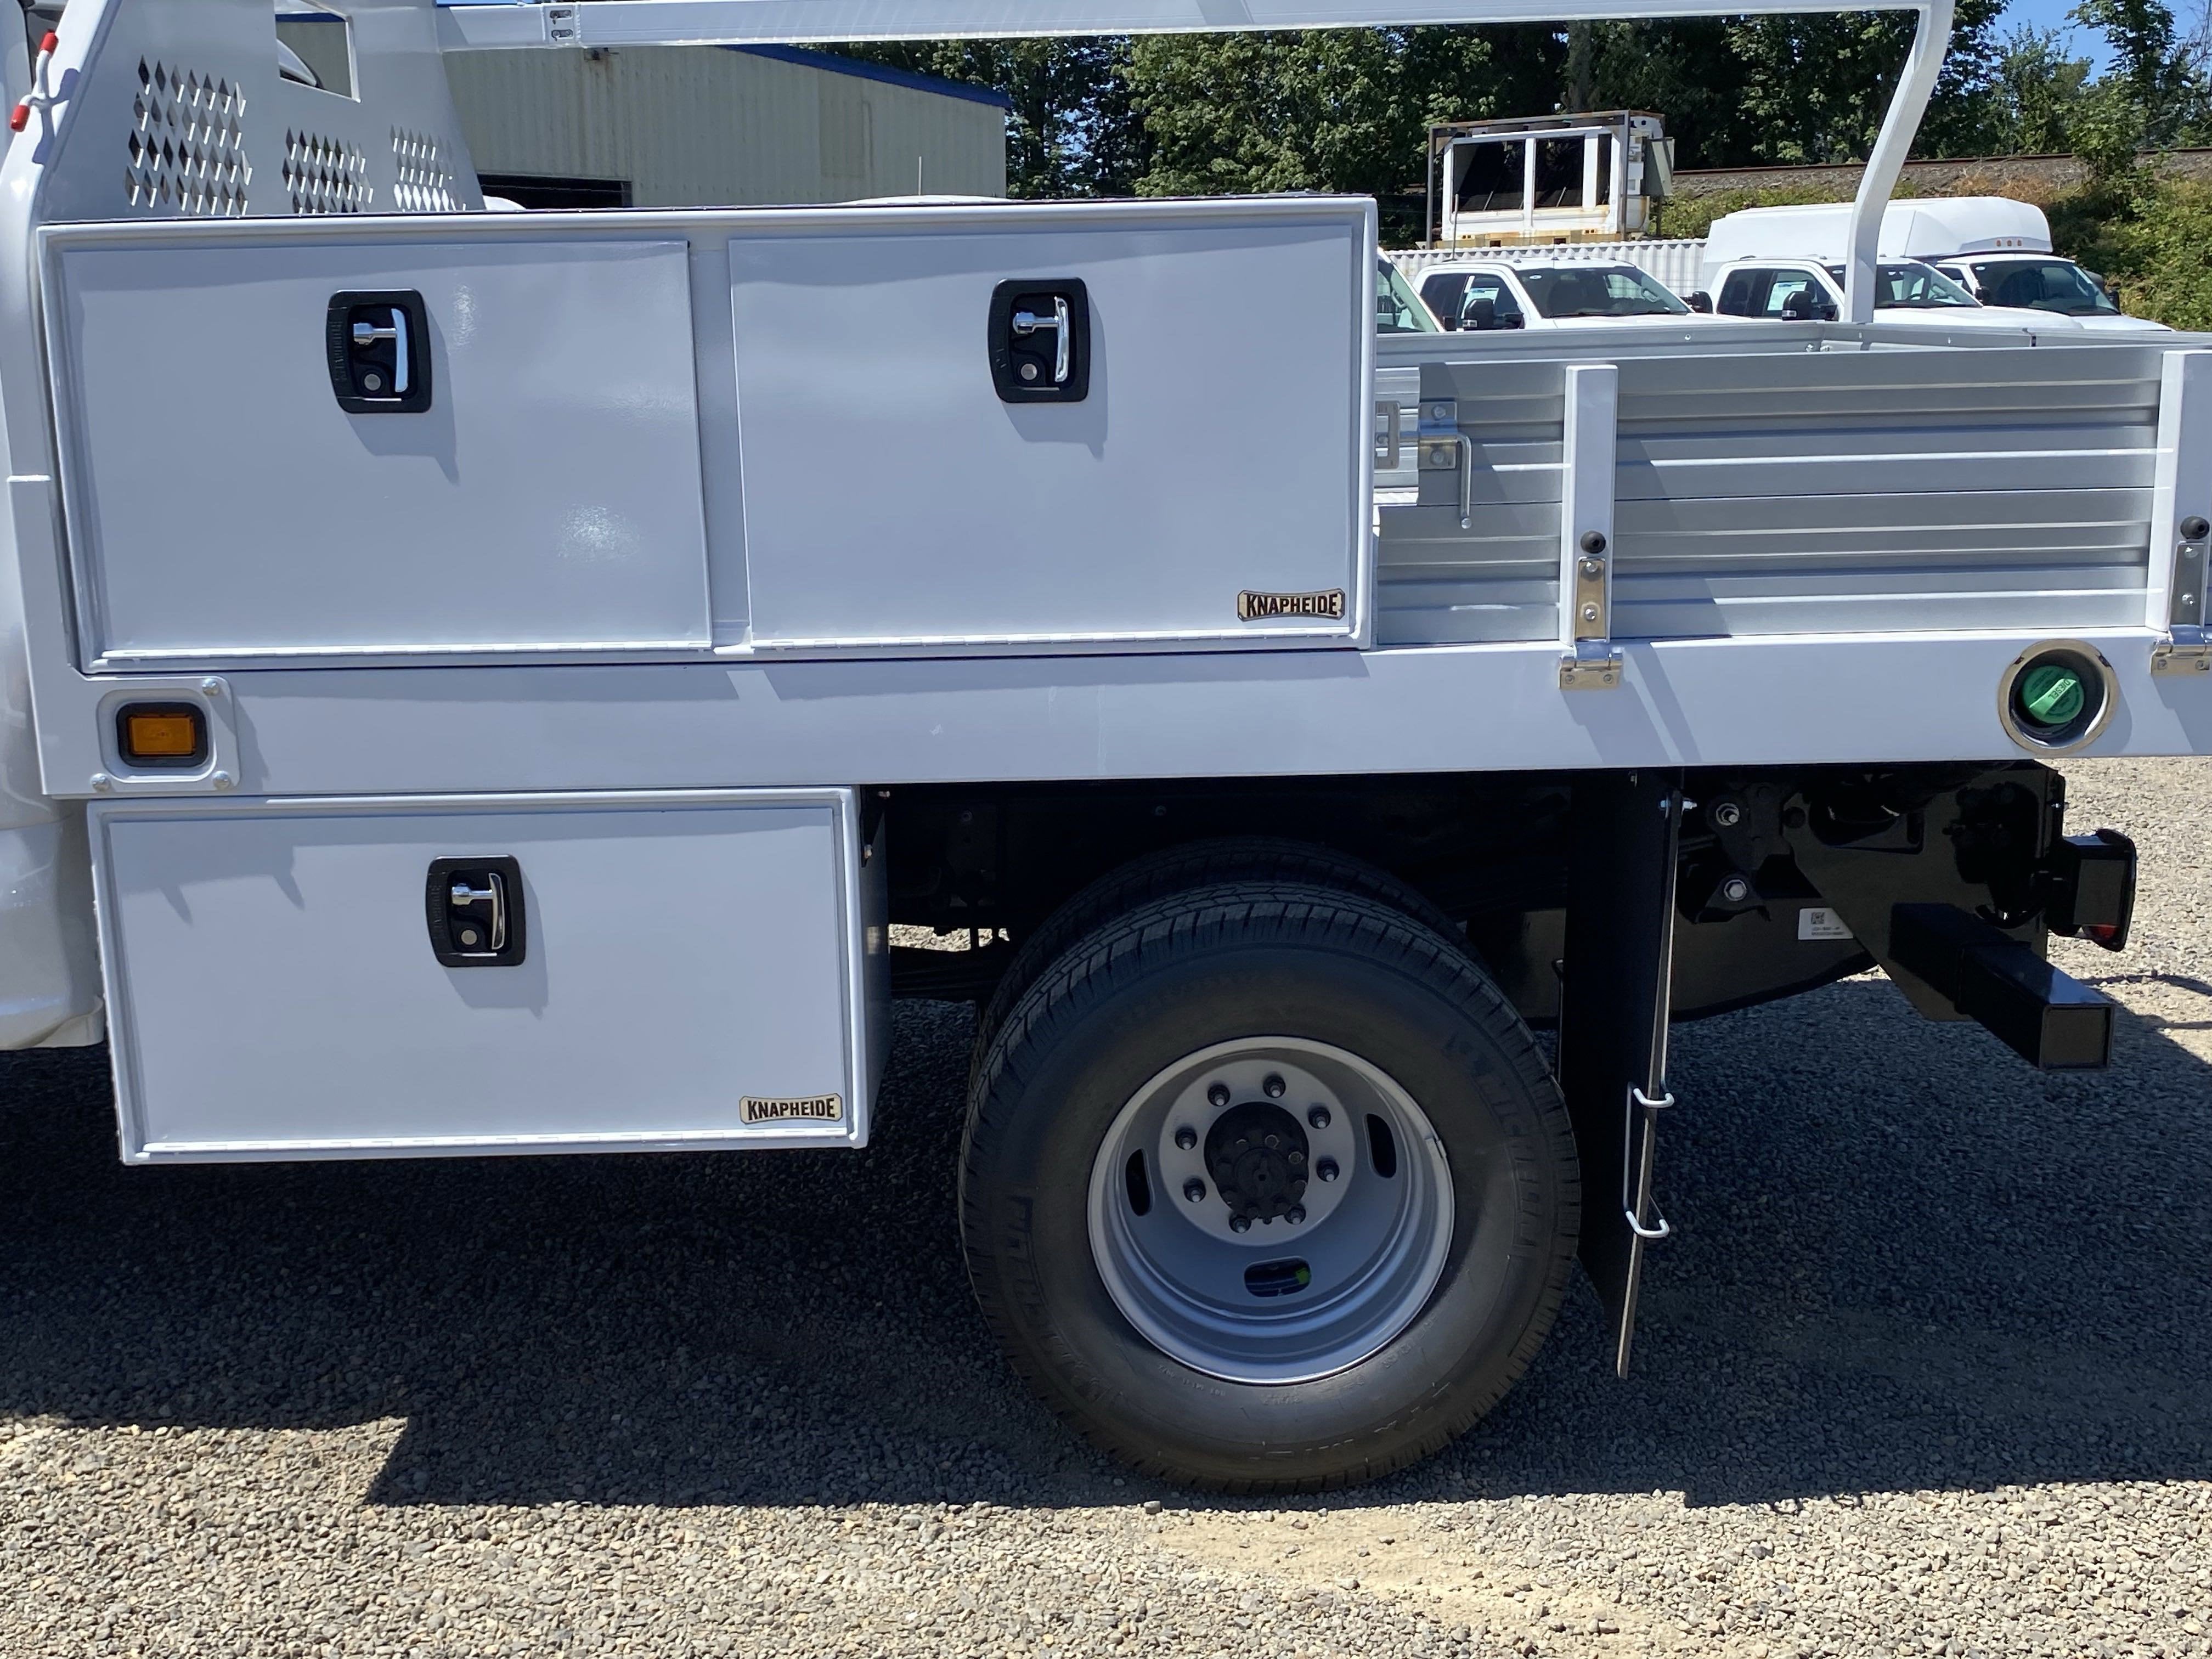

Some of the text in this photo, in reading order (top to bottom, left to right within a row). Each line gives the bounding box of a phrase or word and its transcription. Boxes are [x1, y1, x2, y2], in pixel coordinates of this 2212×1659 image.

[1245, 593, 1338, 617] KNAPHEIDE
[2047, 679, 2071, 699] DIESEL
[747, 1098, 835, 1120] KNAPHEIDE
